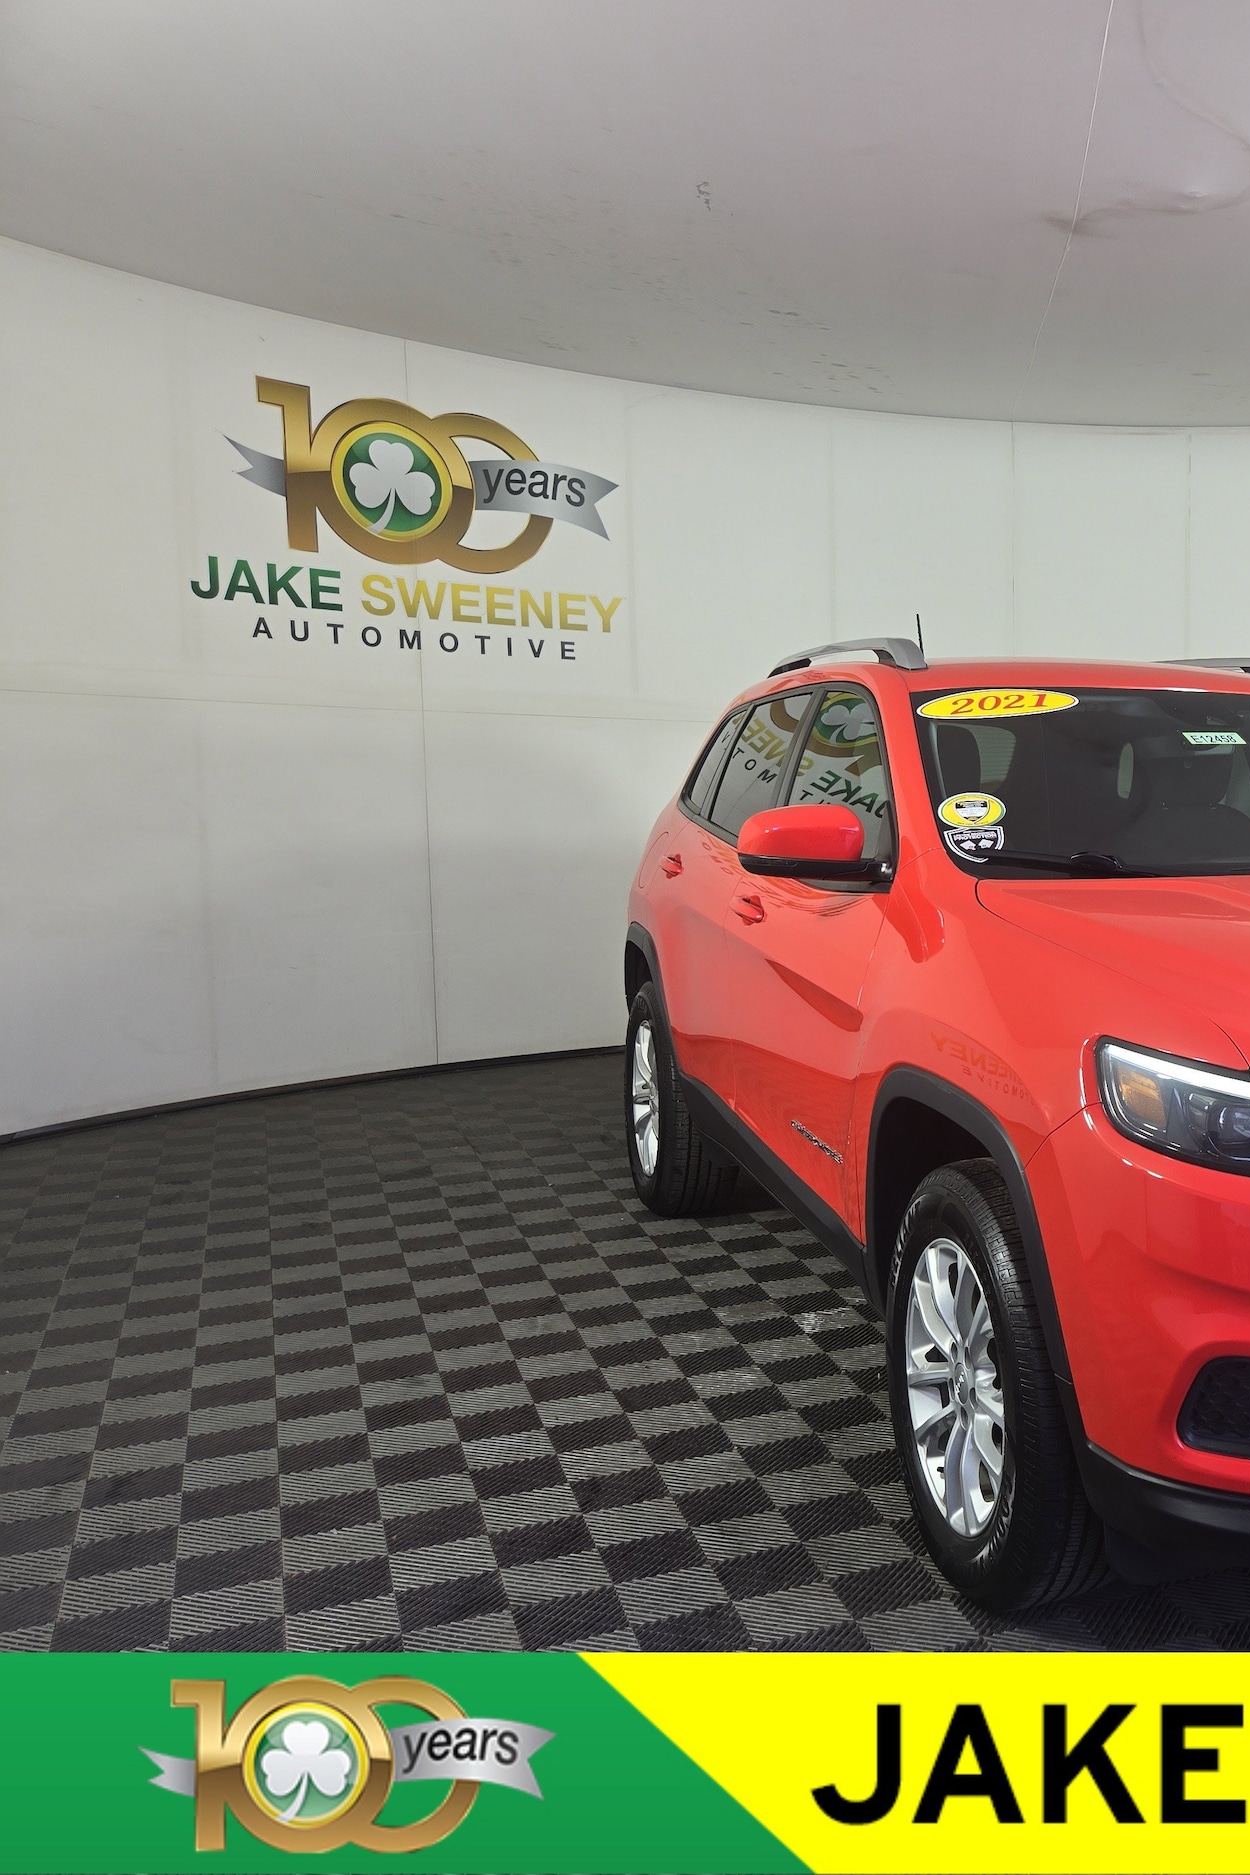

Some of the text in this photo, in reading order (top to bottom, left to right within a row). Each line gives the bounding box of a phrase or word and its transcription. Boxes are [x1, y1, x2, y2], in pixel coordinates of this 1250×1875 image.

[482, 466, 587, 508] years
[190, 555, 623, 633] JAKE SWEENEY
[252, 616, 577, 661] AUTOMOTIVE
[950, 693, 1047, 715] 2021
[1190, 734, 1237, 743] E12458
